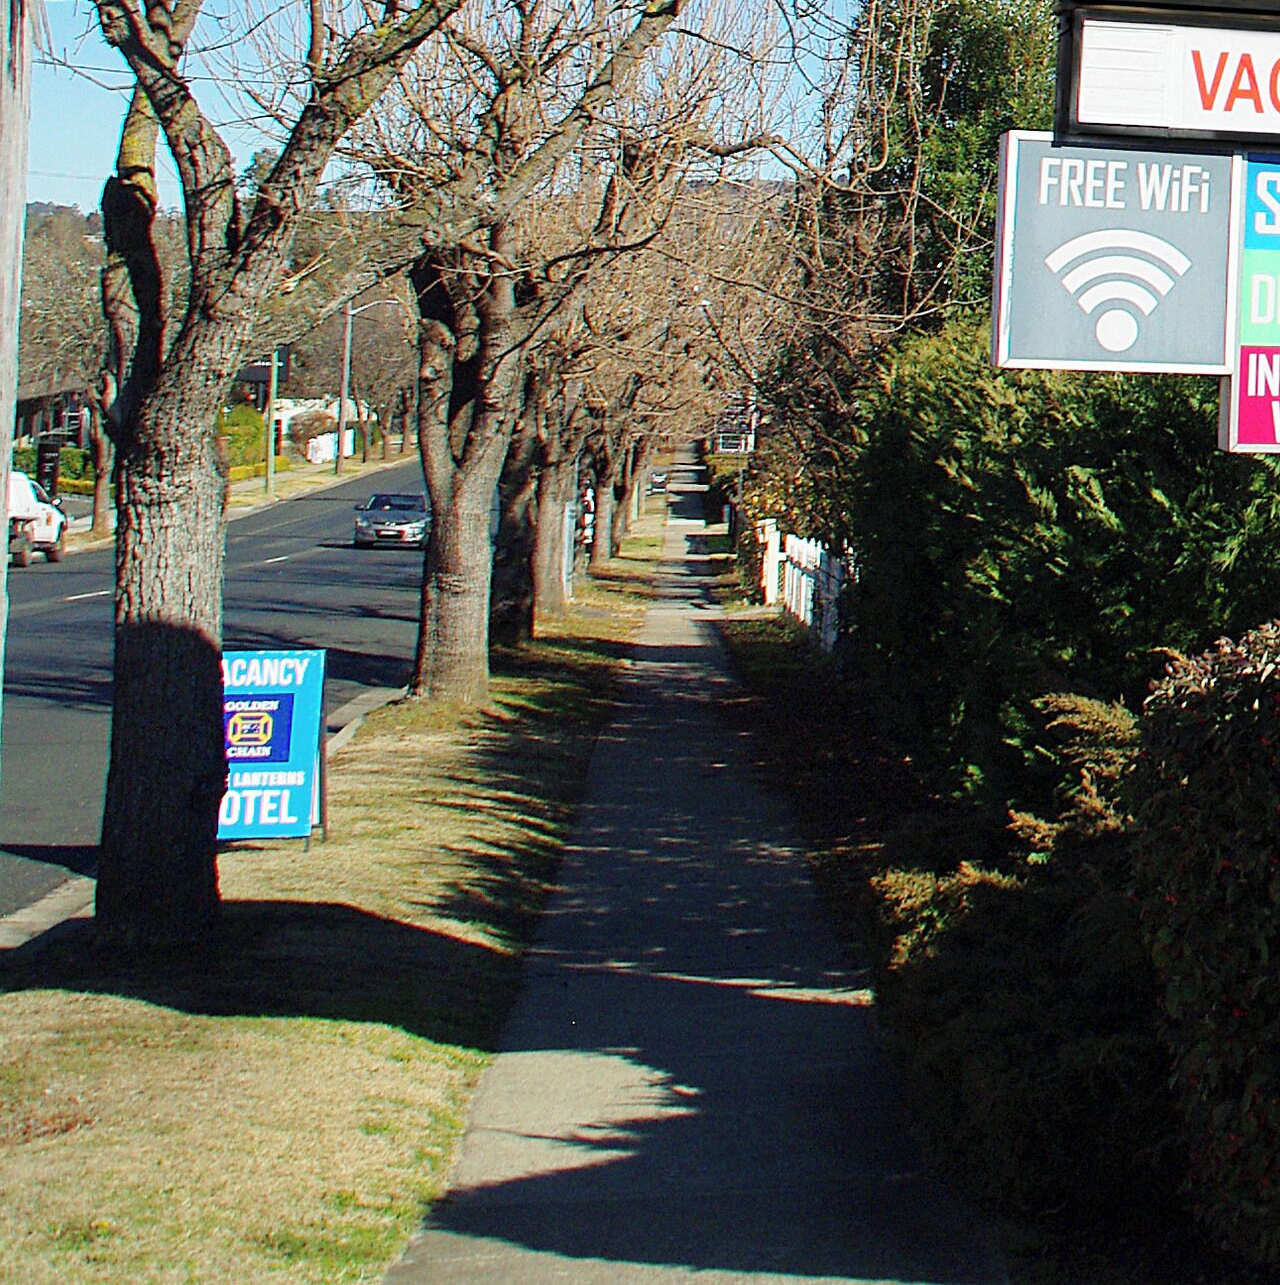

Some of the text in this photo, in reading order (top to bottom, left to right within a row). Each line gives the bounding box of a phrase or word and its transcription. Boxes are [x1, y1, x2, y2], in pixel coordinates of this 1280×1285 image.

[1039, 156, 1210, 214] FREE WiFi
[224, 700, 280, 712] GOLDEN
[225, 746, 272, 758] CHAIN
[218, 789, 299, 826] OTEL
